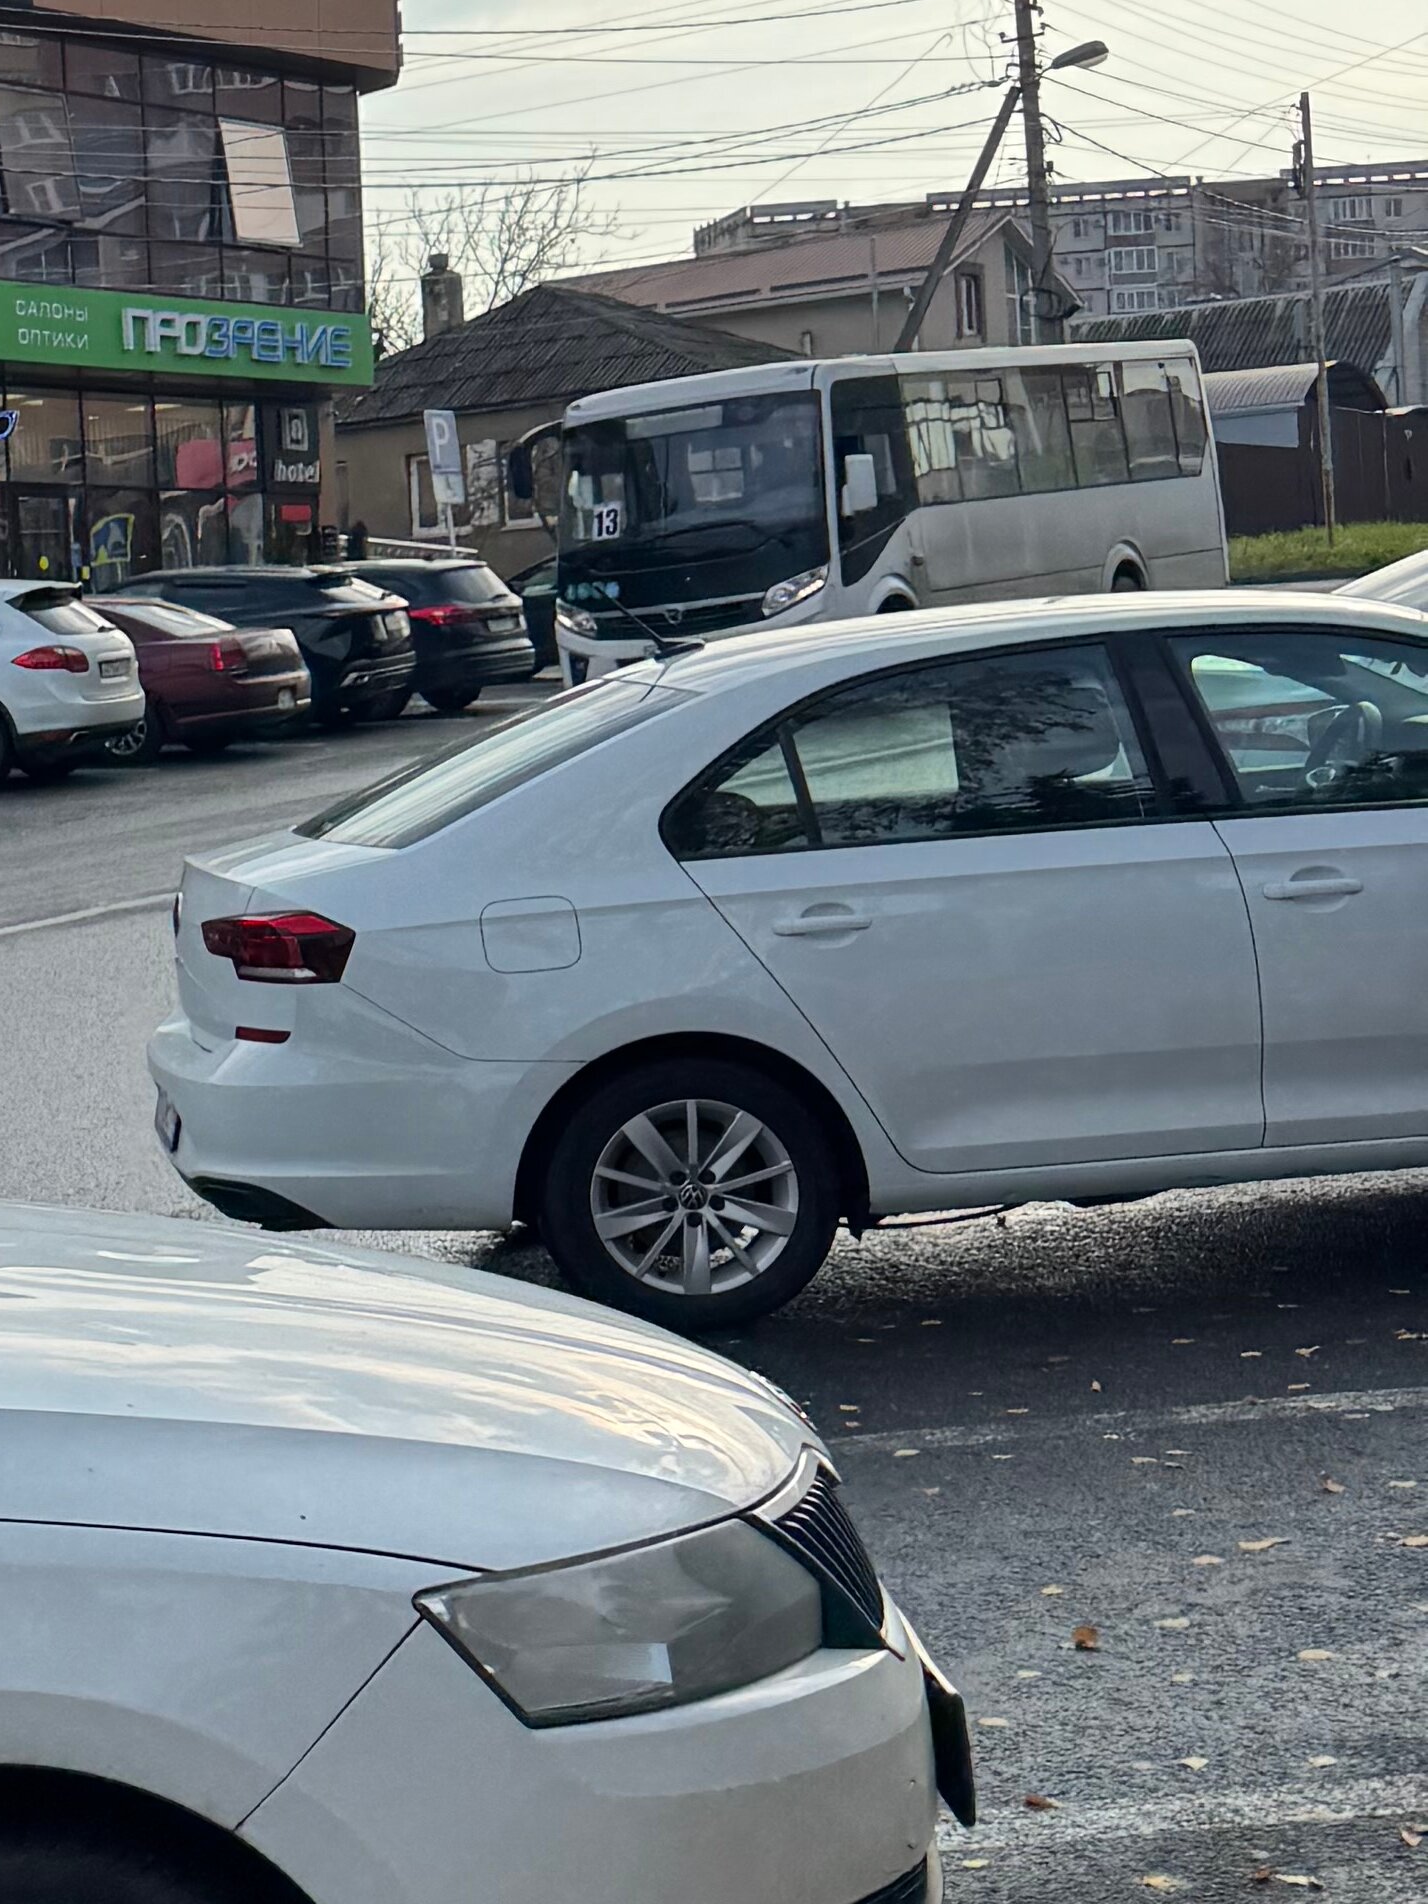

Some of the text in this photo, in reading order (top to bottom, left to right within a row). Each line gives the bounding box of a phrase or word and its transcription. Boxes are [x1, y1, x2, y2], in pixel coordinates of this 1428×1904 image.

[15, 300, 88, 323] САЛОНЫ
[18, 328, 88, 350] ОПТИКИ
[122, 307, 353, 368] ПРОЗРЕНИЕ
[274, 459, 320, 483] hotel
[595, 509, 619, 537] 13
